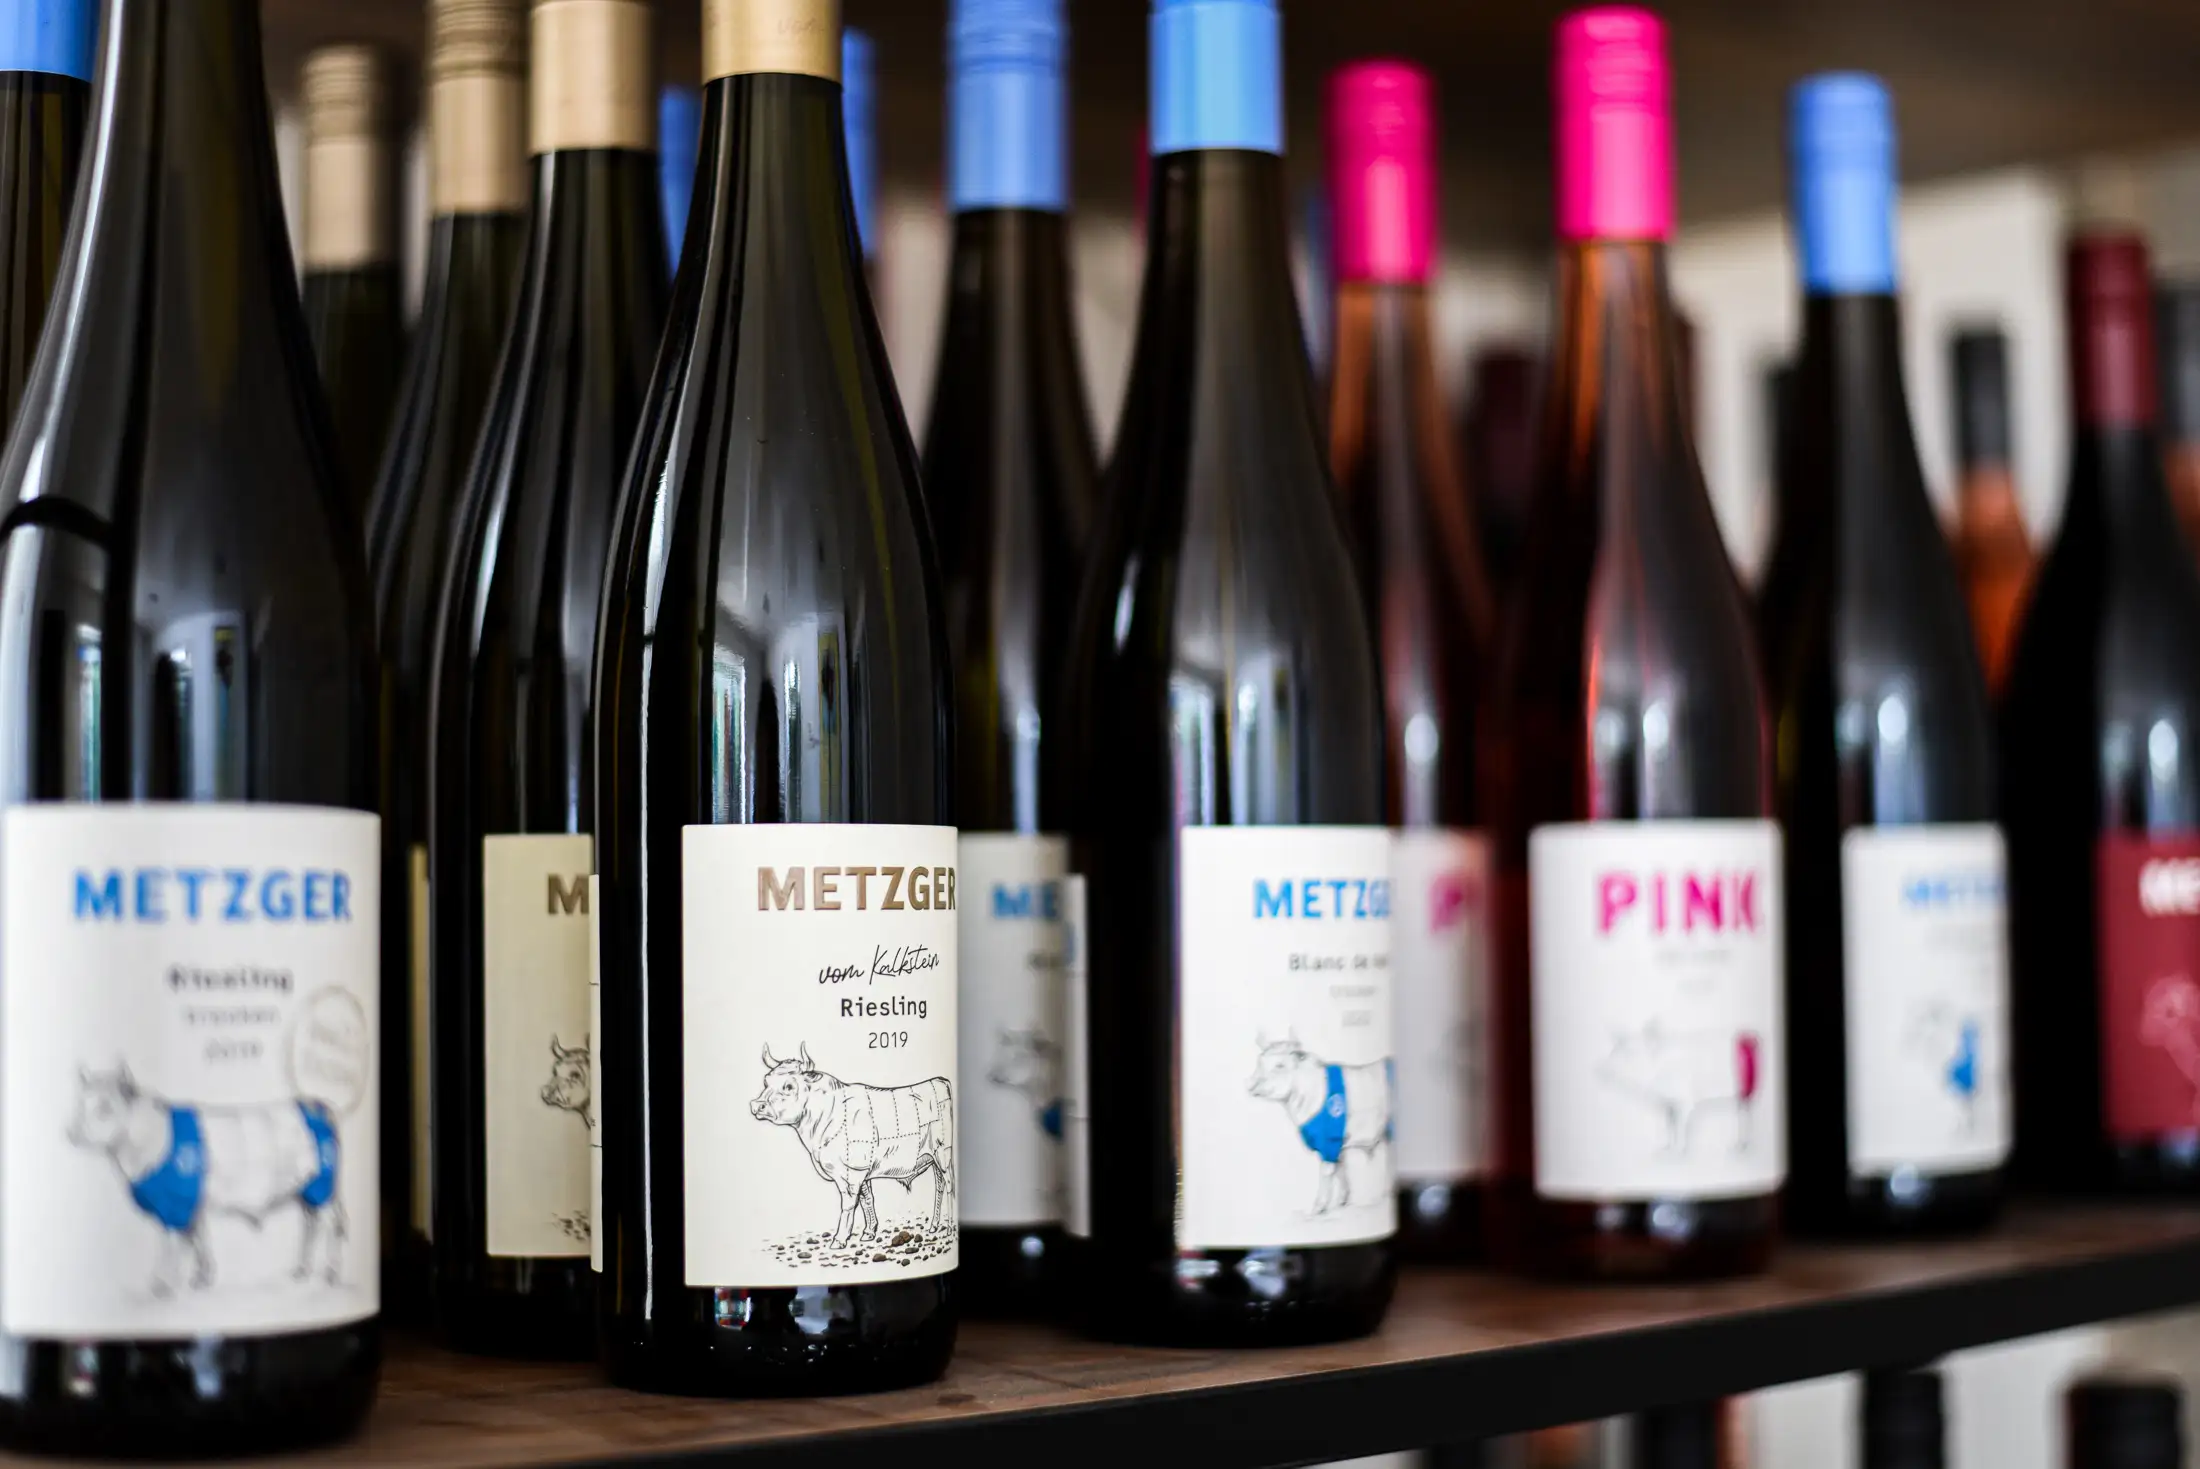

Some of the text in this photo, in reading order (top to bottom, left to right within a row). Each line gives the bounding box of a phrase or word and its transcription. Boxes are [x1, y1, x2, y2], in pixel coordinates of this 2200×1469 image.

[71, 868, 352, 922] METZGER
[757, 866, 957, 911] METZGER
[1597, 871, 1760, 935] PINK
[869, 943, 940, 986] Kalkstein
[840, 995, 928, 1019] Riesling
[867, 1031, 909, 1050] 2019
